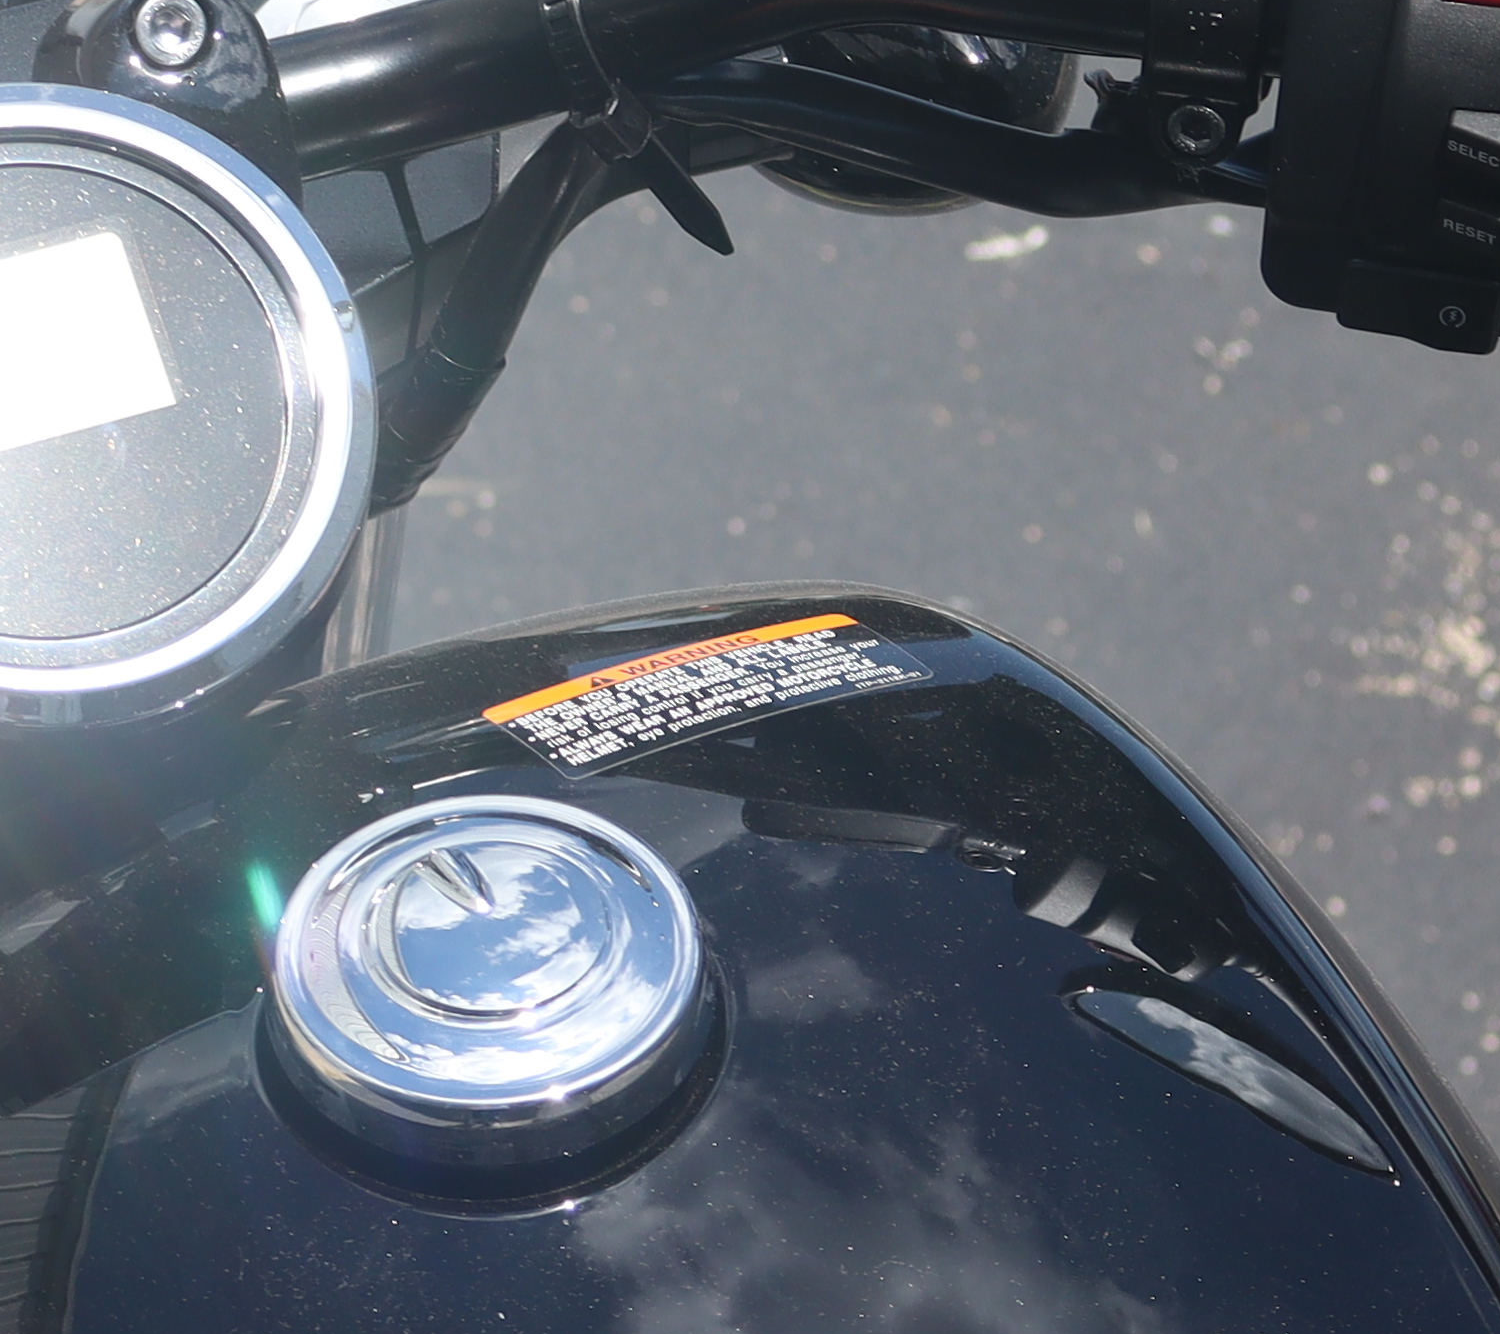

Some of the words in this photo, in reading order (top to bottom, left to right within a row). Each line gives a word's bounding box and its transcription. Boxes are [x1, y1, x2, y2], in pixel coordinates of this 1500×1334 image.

[1443, 218, 1497, 245] RESET
[516, 701, 578, 726] BEFORE
[579, 689, 613, 703] YOU
[616, 667, 686, 692] OPERATE
[686, 657, 723, 670] THIS
[793, 631, 836, 644] READ
[536, 718, 588, 740] NEVER
[590, 699, 641, 721] CARRY
[646, 695, 659, 704] A
[757, 661, 785, 670] You
[787, 647, 847, 663] increase
[850, 640, 879, 652] your
[618, 635, 760, 675] WARNING
[524, 718, 559, 732] THE
[560, 693, 632, 720] OWNER'S
[633, 674, 698, 696] MANUAL
[701, 663, 733, 677] AND
[736, 655, 768, 667] ALL
[548, 735, 575, 748] risk
[578, 727, 592, 737] of
[594, 713, 641, 731] losing
[642, 696, 690, 715] control
[691, 691, 704, 699] if
[707, 684, 734, 696] you
[737, 673, 774, 686] carry
[559, 731, 618, 758] ALWAYS
[618, 715, 667, 735] WEAR
[670, 706, 693, 719] AN
[696, 683, 775, 711] APPROVED
[777, 659, 876, 687] MOTORCYCLE
[638, 728, 665, 741] eye
[744, 695, 773, 708] and
[776, 678, 842, 701] protective
